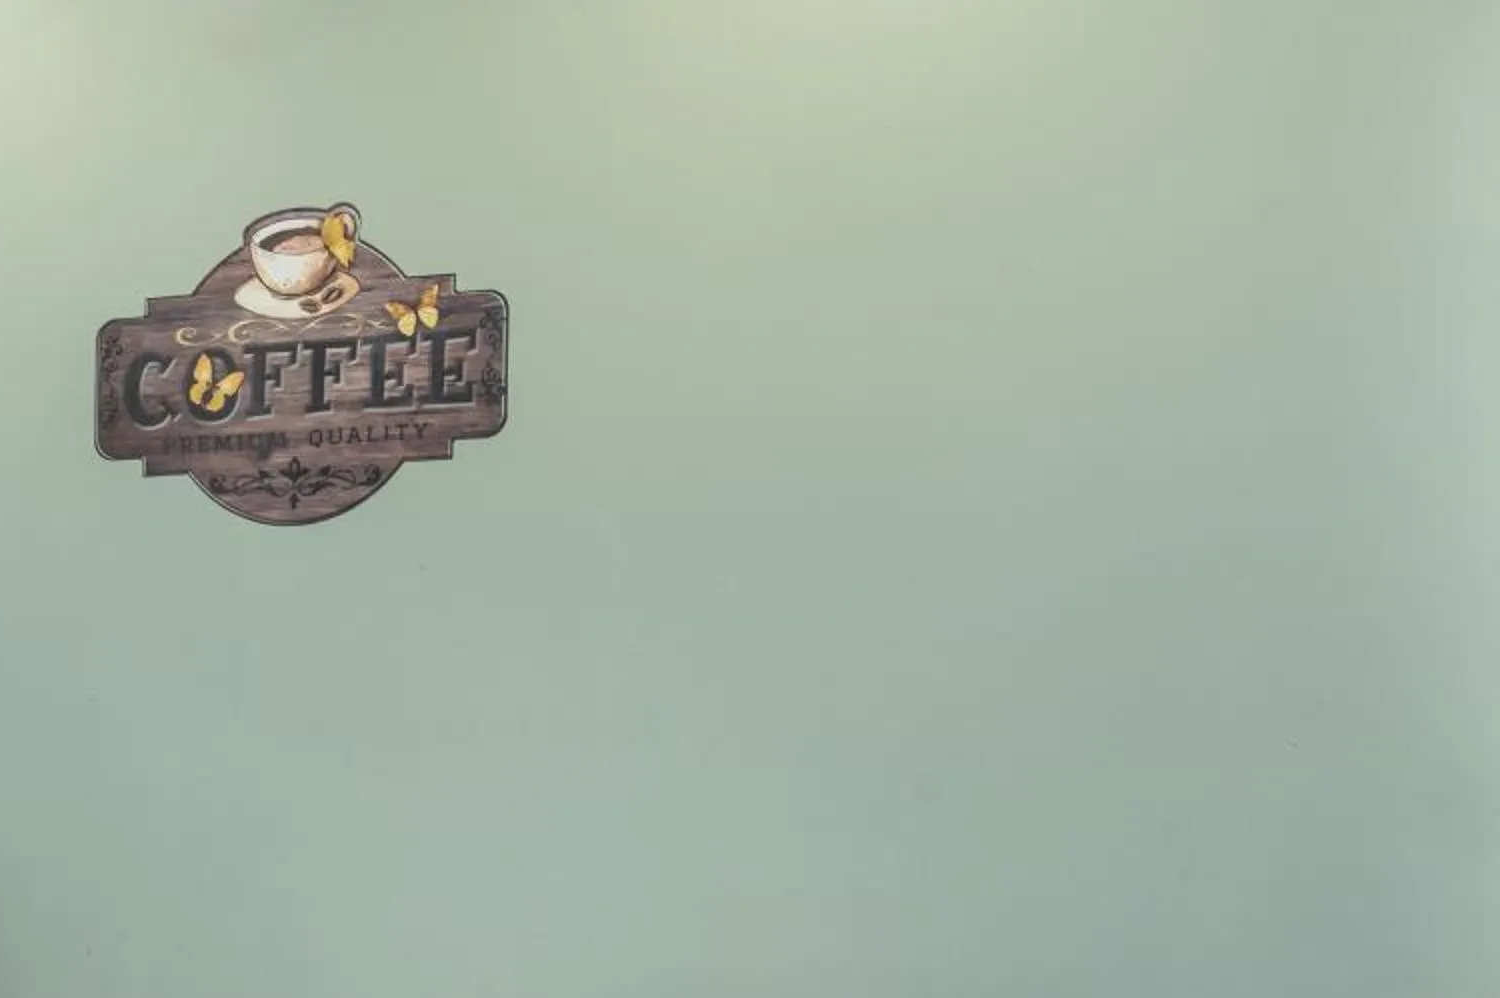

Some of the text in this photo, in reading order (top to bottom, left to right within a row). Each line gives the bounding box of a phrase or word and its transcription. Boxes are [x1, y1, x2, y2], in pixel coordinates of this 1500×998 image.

[121, 328, 478, 427] COFFEE
[162, 423, 429, 454] PREMIUM QUALITY
